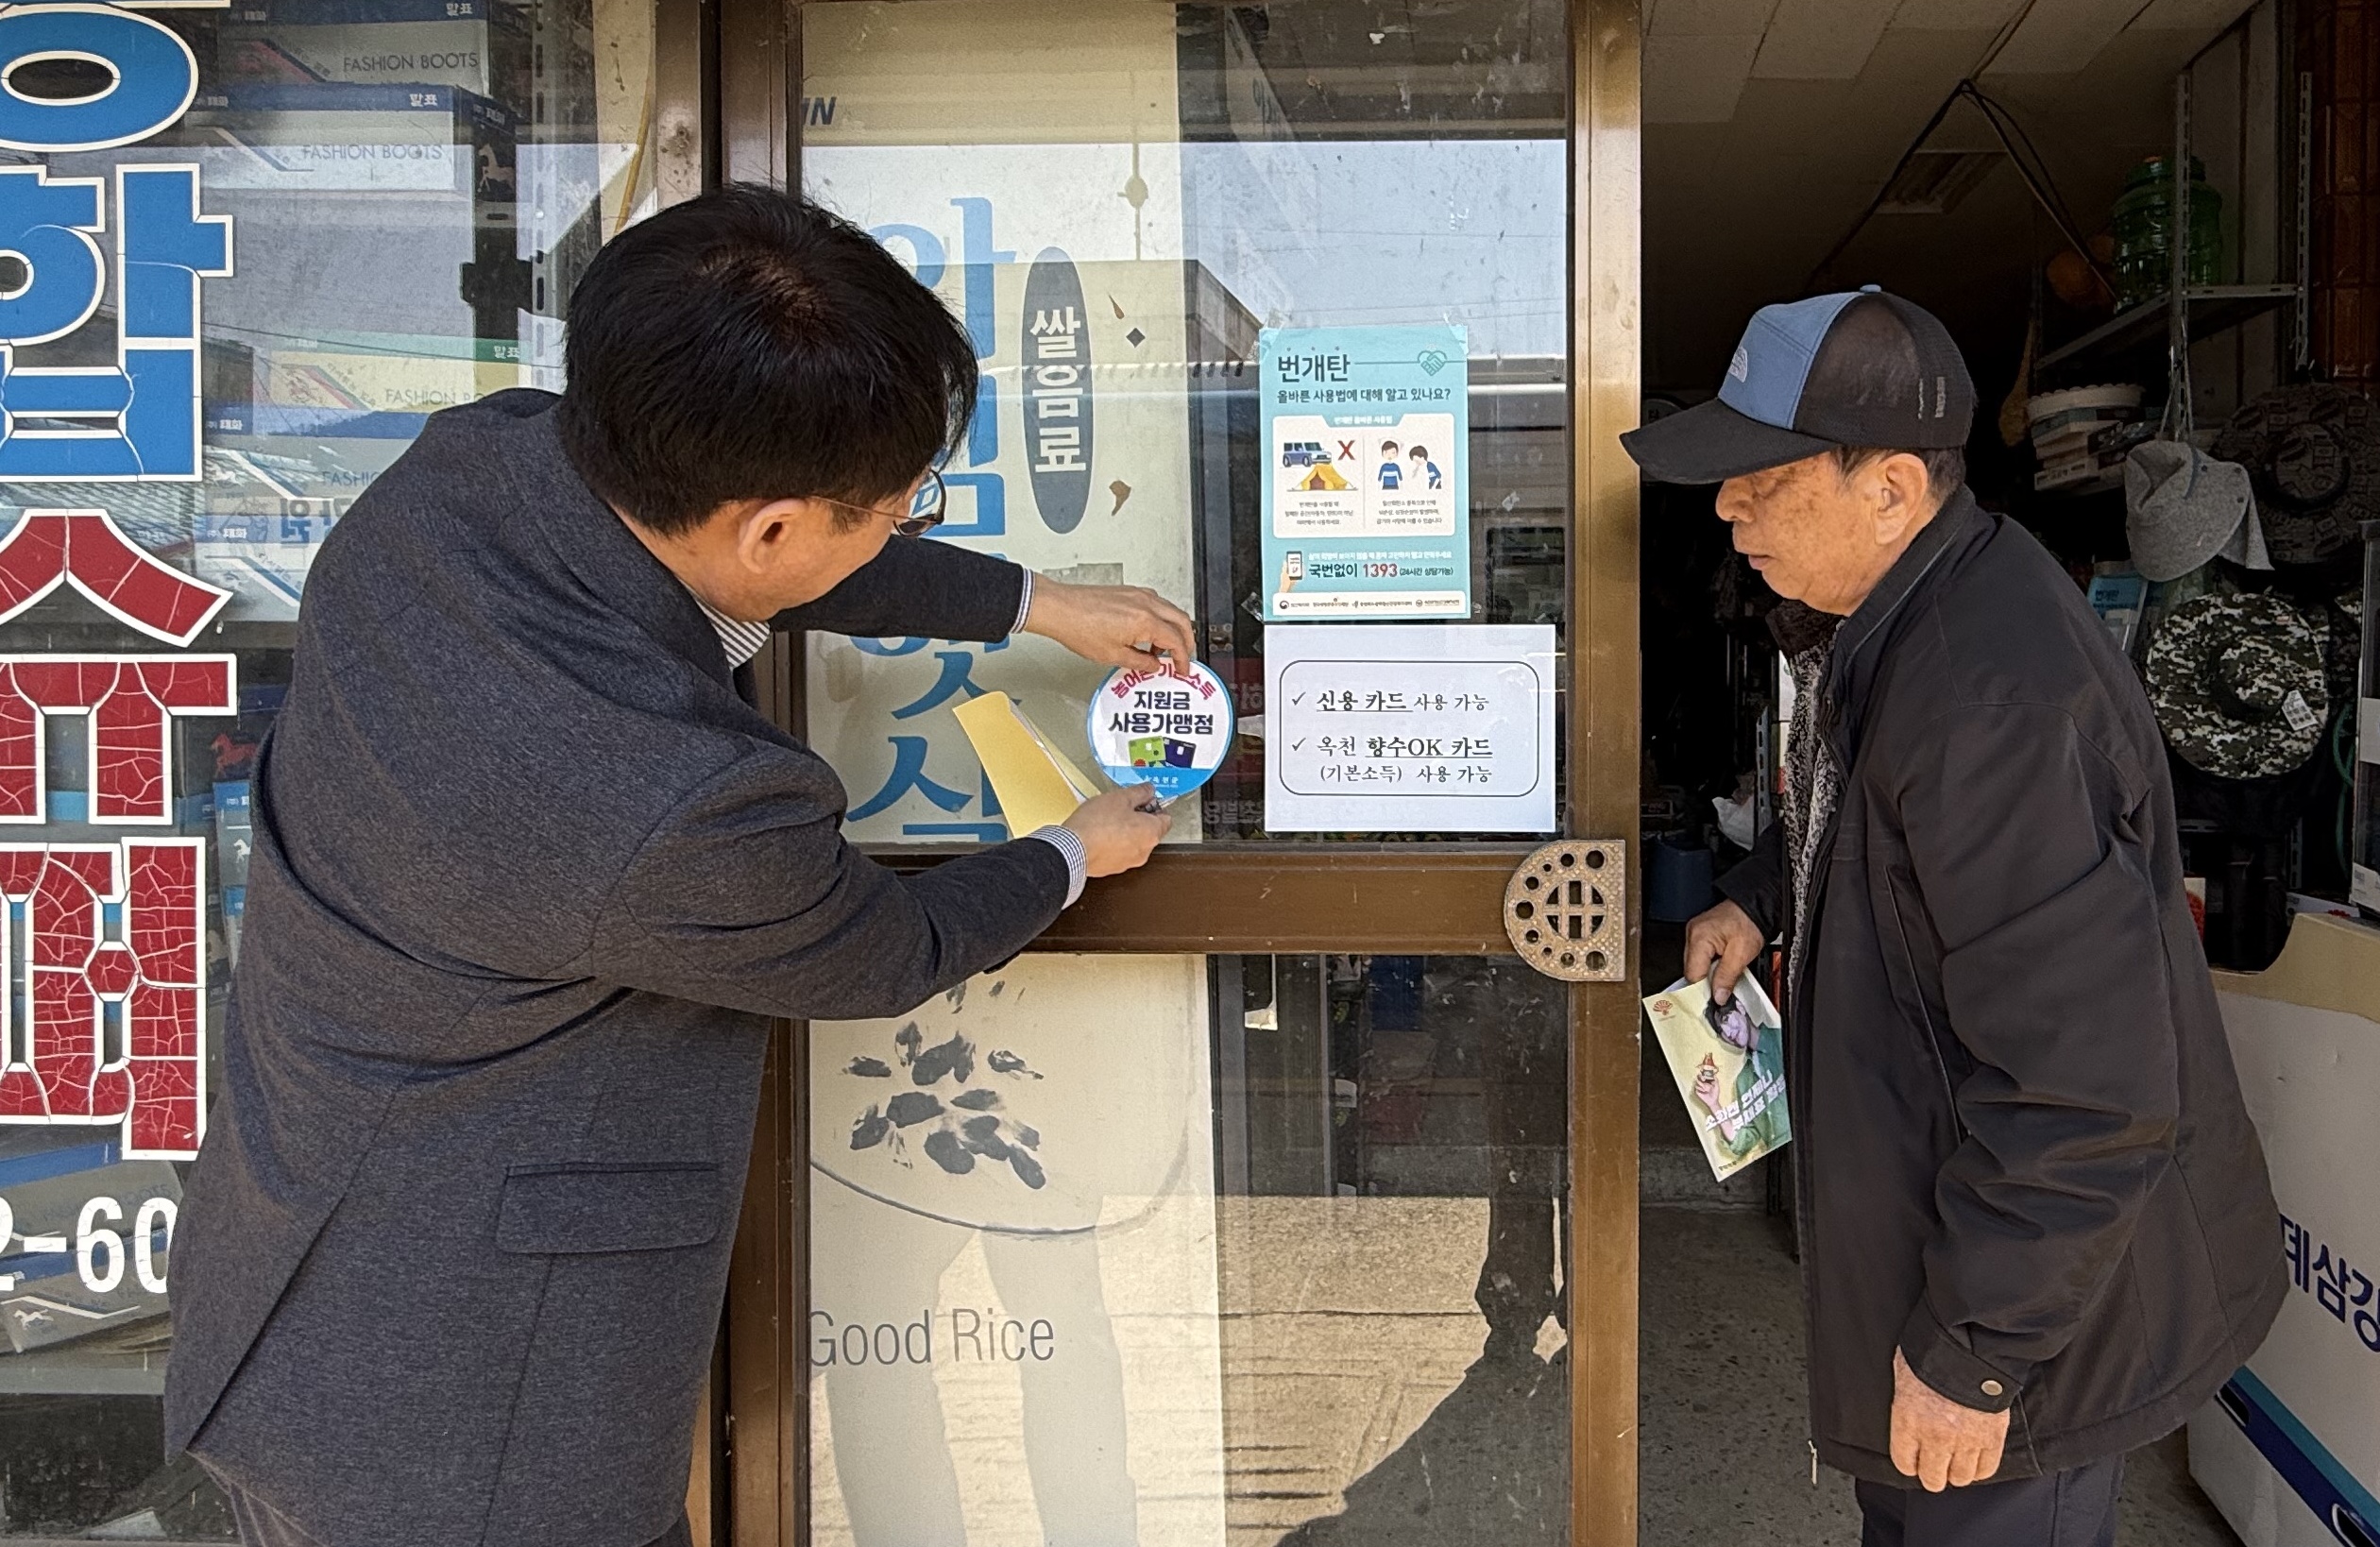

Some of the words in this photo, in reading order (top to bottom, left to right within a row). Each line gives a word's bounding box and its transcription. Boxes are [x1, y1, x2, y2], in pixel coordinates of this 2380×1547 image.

[343, 55, 415, 72] FASHION
[420, 53, 479, 69] BOOTS
[302, 144, 375, 160] FASHION
[382, 144, 443, 159] BOOTS
[1277, 354, 1351, 382] 번개탄
[385, 388, 456, 404] FASHION
[1029, 307, 1085, 473] 쌀음료
[1277, 389, 1311, 404] 올바른
[1314, 388, 1357, 403] 사용법에
[1361, 388, 1383, 402] 대해
[1386, 388, 1408, 401] 알고
[1411, 387, 1451, 401] 있나요?
[1309, 564, 1358, 578] 국번없이
[1363, 563, 1398, 578] 1393
[1134, 690, 1191, 710] 지원금
[1317, 690, 1358, 711] 신용
[1366, 690, 1406, 710] 카드
[1414, 693, 1448, 711] 사용
[1454, 693, 1489, 711] 가능
[1108, 713, 1214, 735] 사용가맹점
[1317, 736, 1356, 757] 옥천
[1366, 736, 1443, 757] 향수OK
[1452, 737, 1493, 757] 카드
[1320, 765, 1402, 782] (기본소득)
[1417, 765, 1451, 783] 사용
[1457, 765, 1492, 783] 가능
[809, 1310, 931, 1367] Good
[953, 1307, 1055, 1362] Rice
